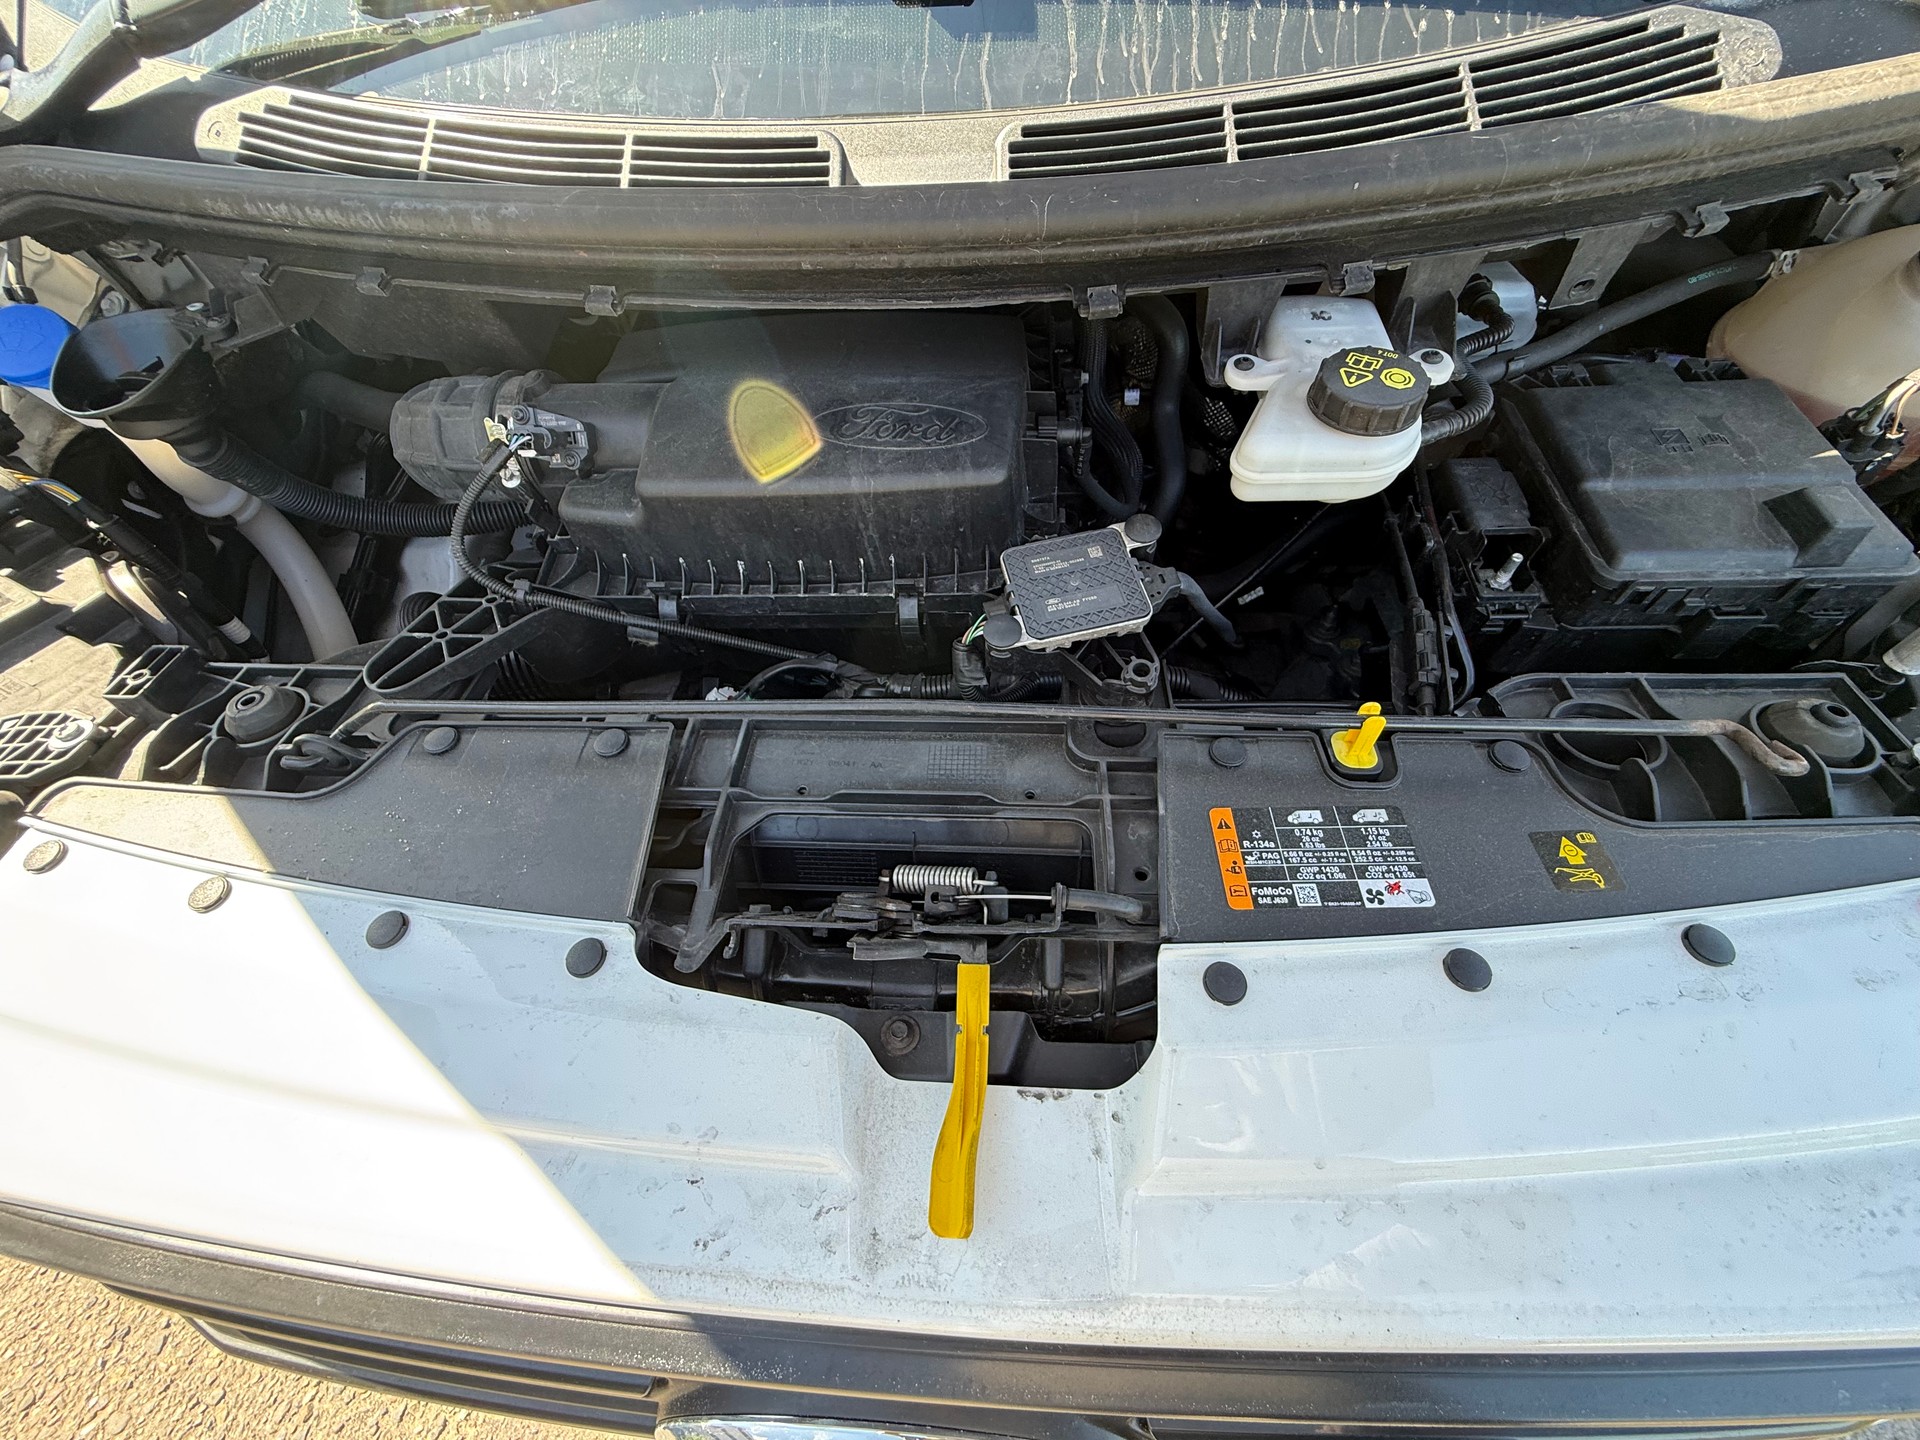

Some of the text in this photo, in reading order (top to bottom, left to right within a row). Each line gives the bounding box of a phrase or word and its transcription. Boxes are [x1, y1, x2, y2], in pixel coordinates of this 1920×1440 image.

[831, 405, 960, 442] Ford
[1294, 828, 1324, 837] 0.74 kg
[1378, 828, 1390, 836] kg
[1243, 840, 1275, 848] R-134a
[1262, 852, 1280, 860] PAG
[1251, 887, 1292, 896] FoMoCo
